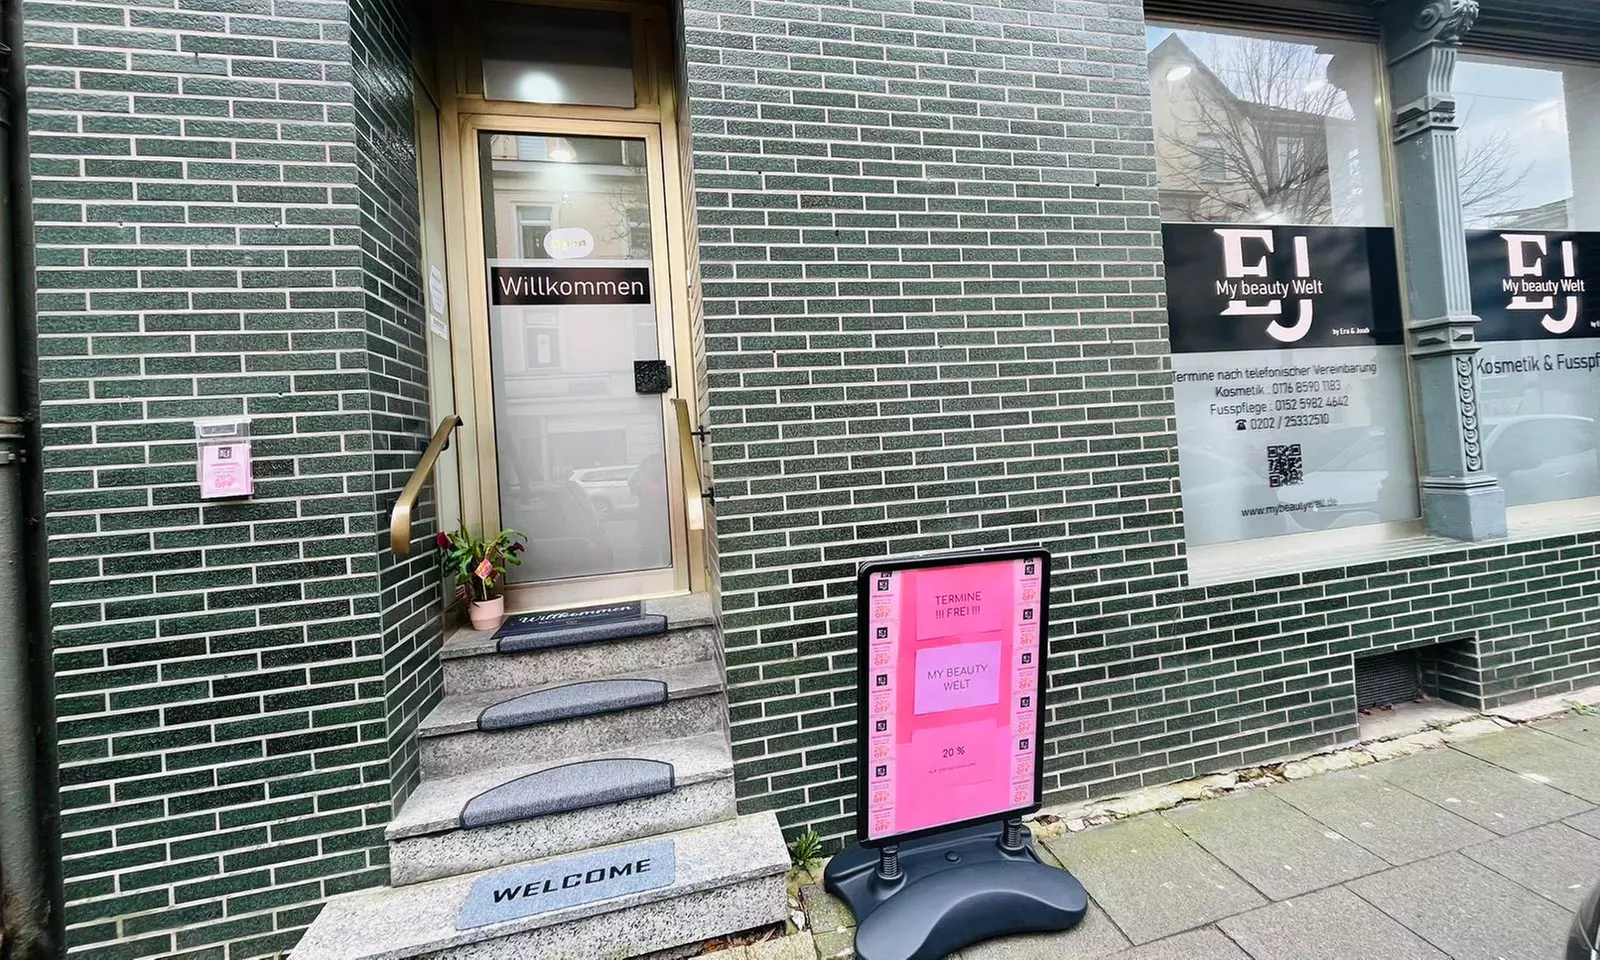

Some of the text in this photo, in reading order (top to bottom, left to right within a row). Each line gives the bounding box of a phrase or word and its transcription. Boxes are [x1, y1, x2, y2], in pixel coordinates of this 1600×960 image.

[500, 276, 644, 296] Willkommen
[1216, 279, 1324, 299] My beauty Welt
[1502, 279, 1586, 295] My beauty Welt
[1217, 369, 1243, 381] nach
[1245, 365, 1311, 379] telefonischer
[1314, 362, 1377, 377] Vereinbarung
[1477, 356, 1540, 375] Kosmetik
[1543, 354, 1553, 371] &
[1215, 384, 1265, 398] Kosmetik
[1272, 383, 1294, 395] 0176
[1296, 381, 1320, 394] 8590
[1322, 380, 1341, 391] 1183
[1210, 402, 1267, 417] Fusspflege
[1275, 399, 1297, 411] 0152
[1300, 397, 1324, 410] 5982
[1326, 396, 1349, 408] 4642
[1251, 418, 1275, 430] 0202
[935, 591, 982, 605] TERMINE
[518, 604, 635, 624] Willkommen
[947, 606, 970, 618] FREI
[927, 664, 989, 680] MY BEAUTY
[943, 679, 971, 691] WELT
[942, 746, 966, 758] 20 %
[493, 858, 651, 903] WELCOME
